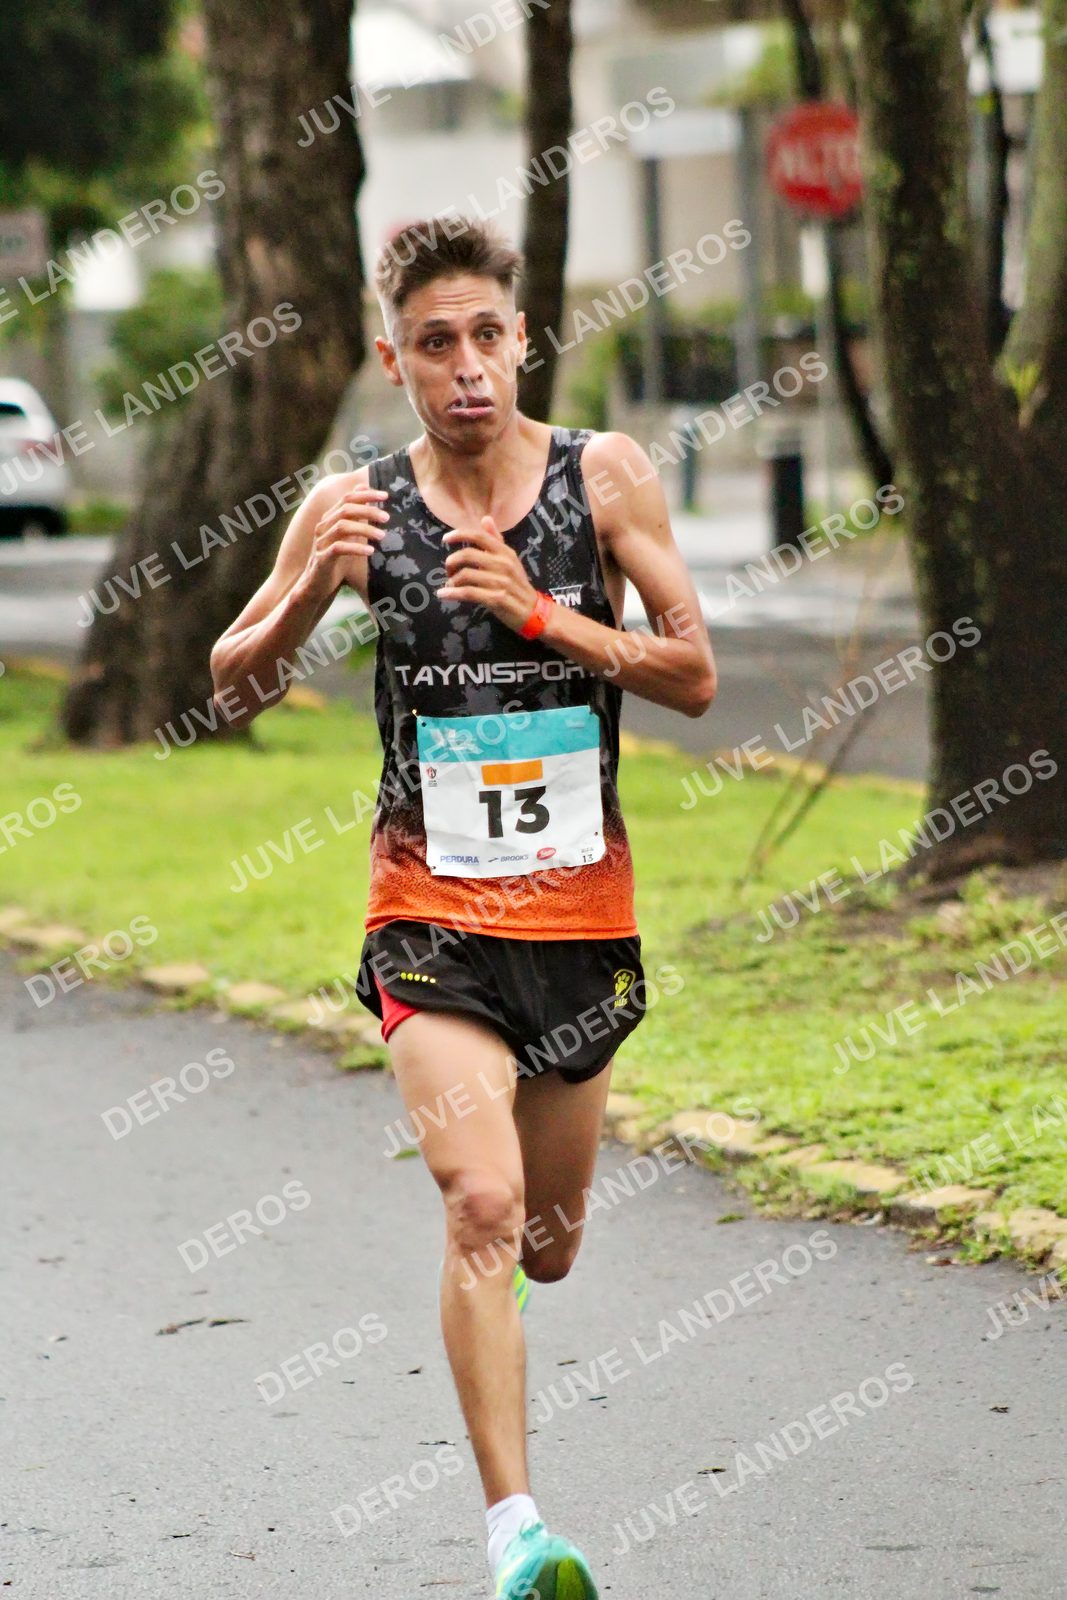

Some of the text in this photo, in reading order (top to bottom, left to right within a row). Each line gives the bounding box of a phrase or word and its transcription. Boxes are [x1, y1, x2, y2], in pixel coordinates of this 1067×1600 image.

[554, 591, 582, 607] TYN
[394, 660, 595, 686] TAYNISPOR
[478, 785, 551, 839] 13
[440, 855, 480, 864] PERDURA
[500, 854, 529, 863] BROOKS
[582, 853, 594, 863] 13
